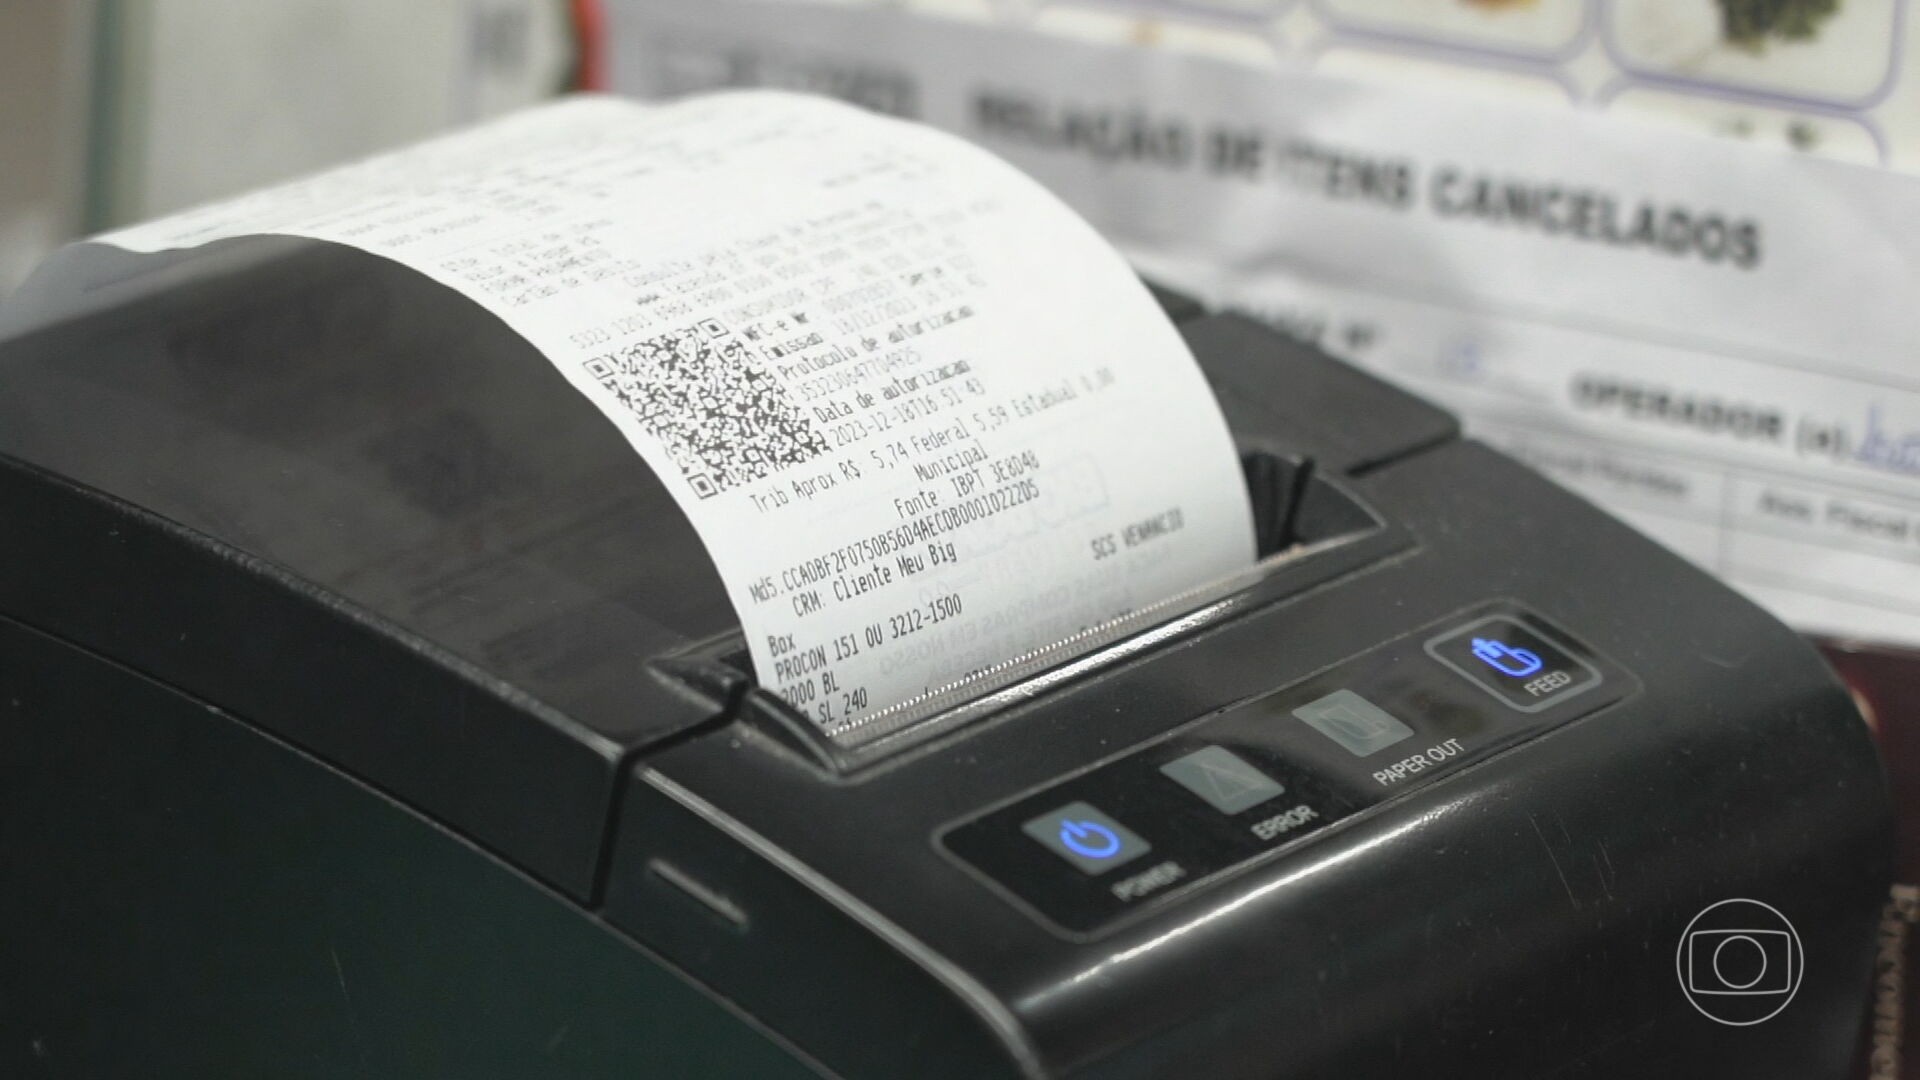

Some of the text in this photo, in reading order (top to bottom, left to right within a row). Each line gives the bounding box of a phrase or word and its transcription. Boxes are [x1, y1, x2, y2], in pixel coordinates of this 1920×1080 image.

[1208, 126, 1263, 180] DE
[1430, 163, 1762, 269] CANCELADOS
[812, 401, 855, 424] Data
[855, 390, 877, 409] de
[1568, 367, 1785, 444] OPERADOR
[749, 485, 790, 514] Trib
[791, 471, 838, 500] Aprox
[870, 441, 910, 470] 5,74
[910, 416, 971, 453] Federal
[913, 438, 989, 483] Municipal
[950, 468, 986, 498] IBPT
[833, 563, 893, 602] Cliente
[896, 555, 926, 579] Meu
[929, 541, 958, 563] Big
[767, 632, 797, 659] Box
[775, 593, 963, 682] PROCON 151 OU 3212-1500
[822, 670, 841, 696] BL
[1522, 670, 1573, 697] FEED
[818, 700, 836, 724] SL
[843, 686, 868, 716] 240
[1372, 737, 1465, 786] PAPER OUT
[1250, 804, 1319, 841] ERROR
[1110, 860, 1188, 902] POWER
